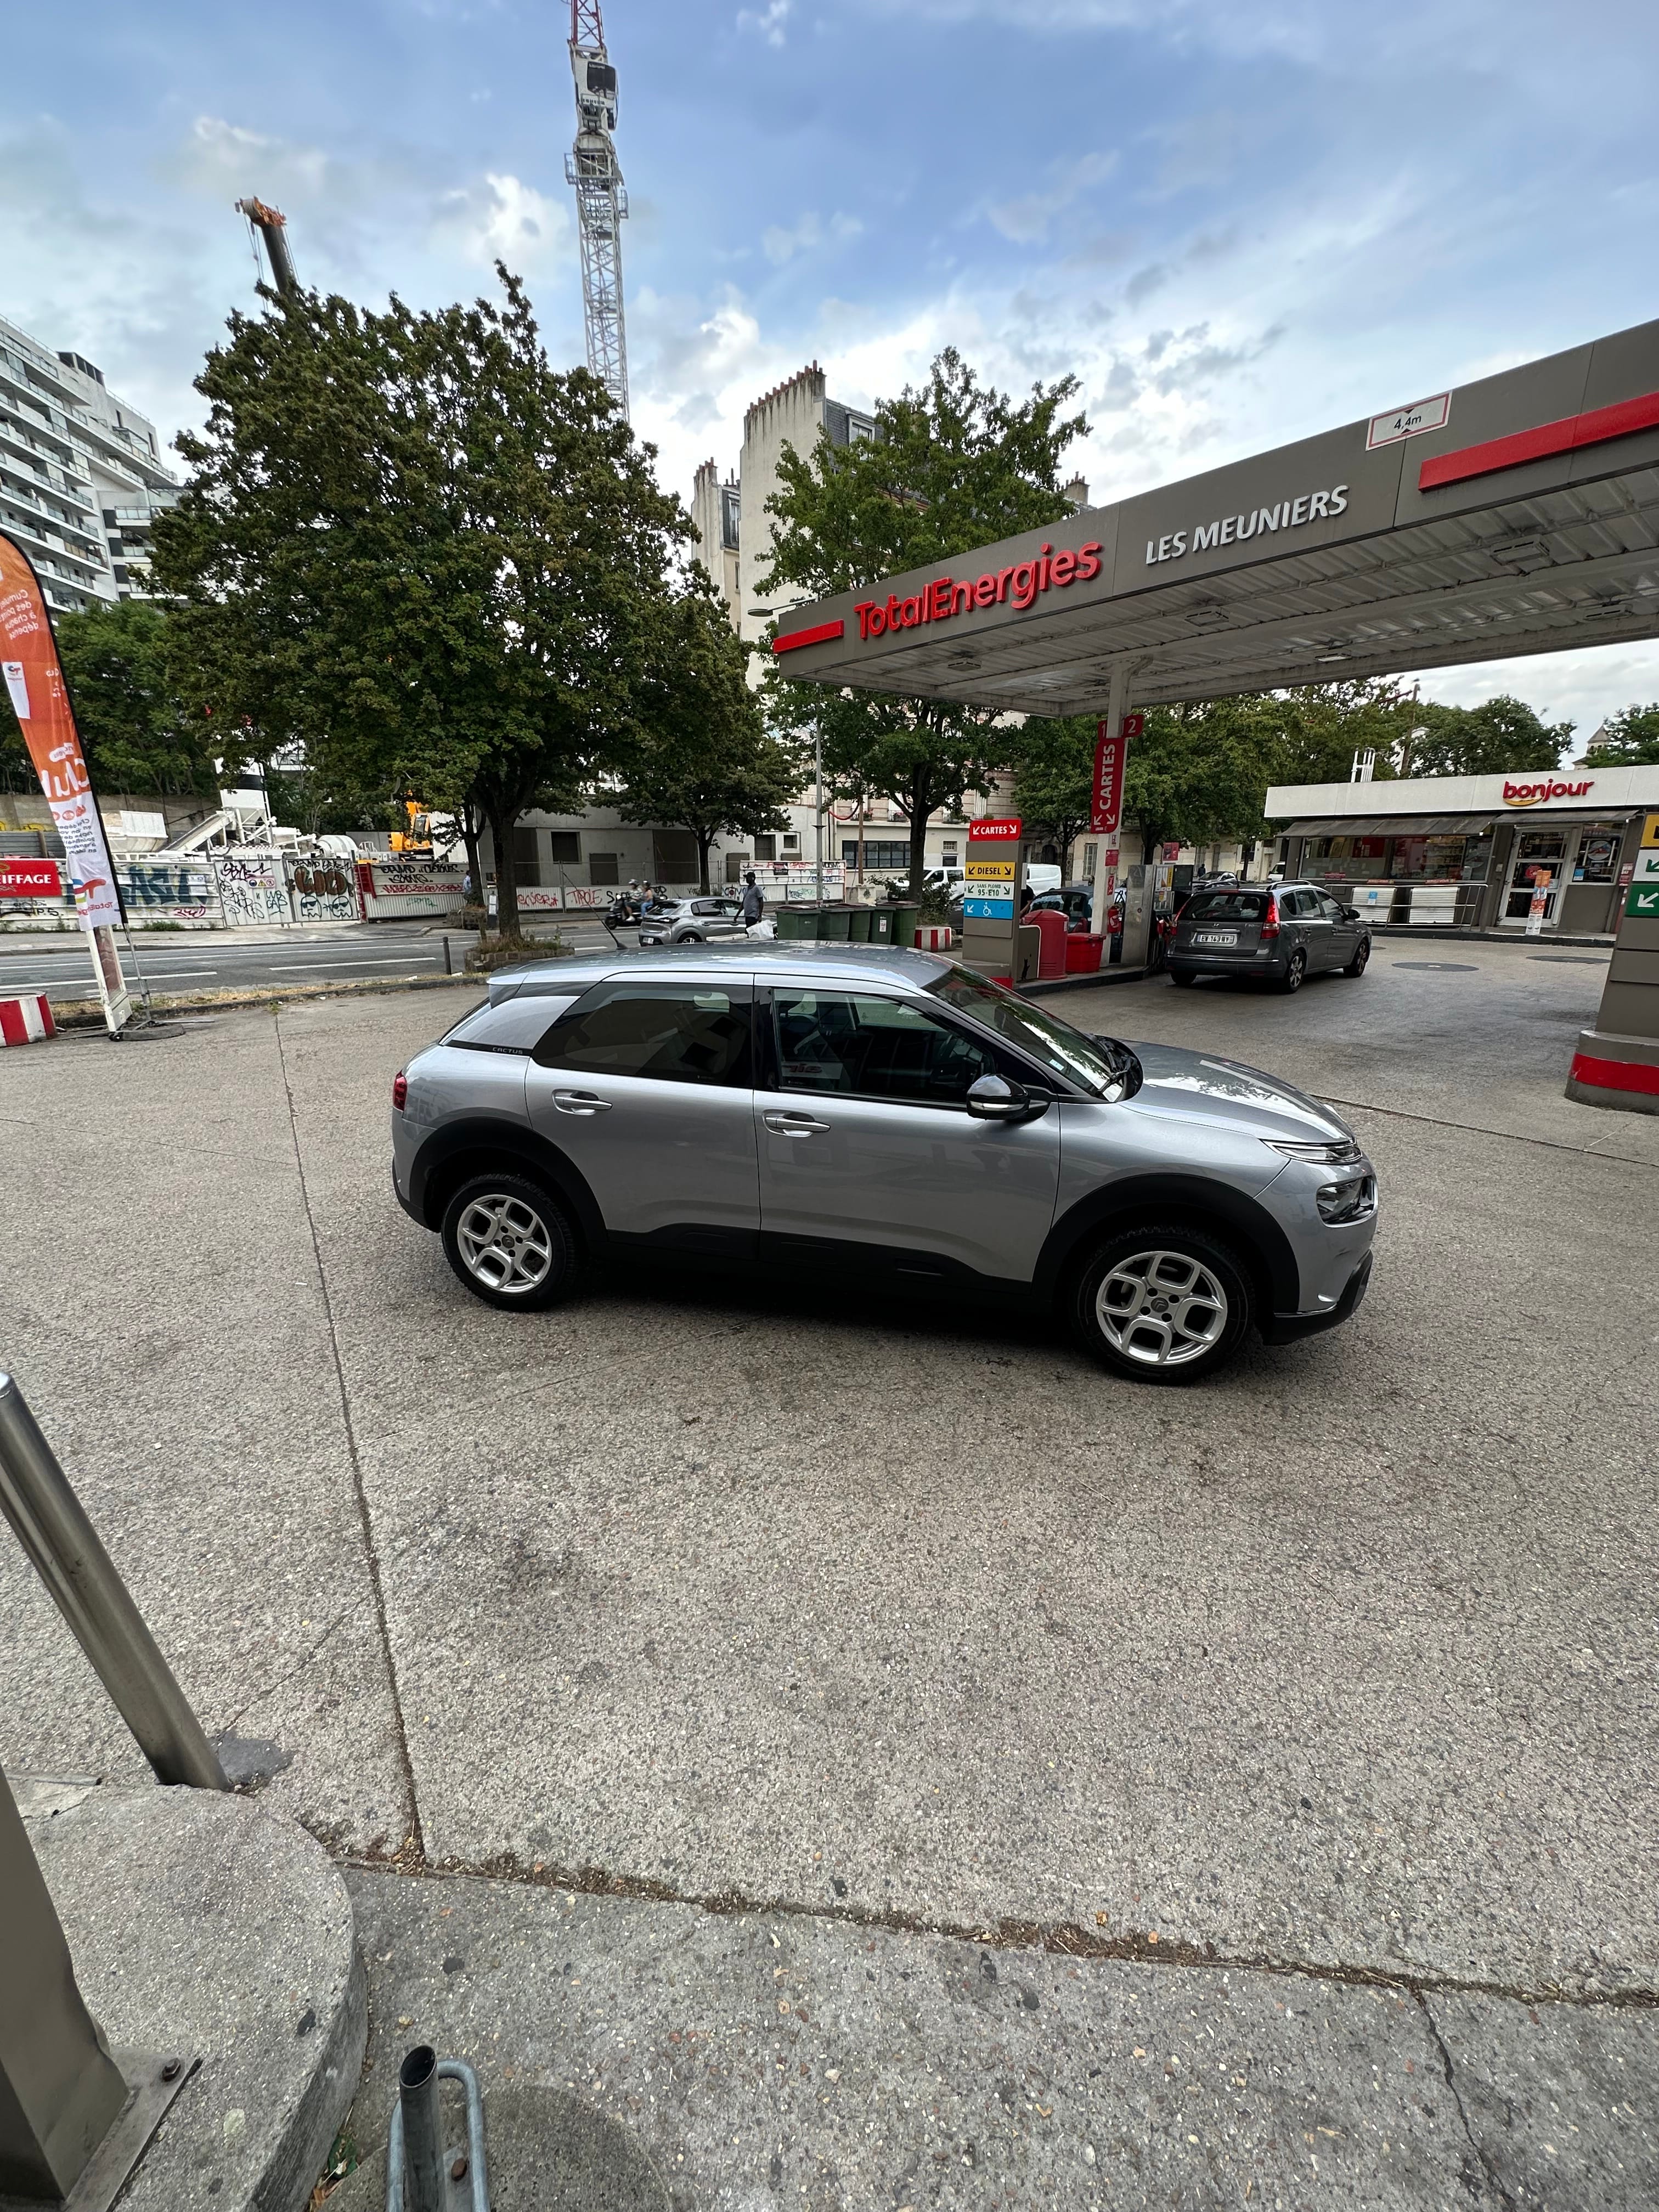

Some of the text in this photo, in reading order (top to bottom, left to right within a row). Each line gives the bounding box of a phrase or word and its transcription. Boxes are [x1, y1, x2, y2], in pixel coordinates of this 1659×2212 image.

[1394, 415, 1421, 430] 4,4m
[1146, 485, 1349, 566] LES MEUNIERS
[854, 541, 1103, 641] TotalEnergies
[1128, 719, 1137, 733] 2
[1099, 744, 1116, 810] CARTES
[1503, 778, 1595, 802] bonjour
[980, 826, 1007, 835] CARTES
[977, 867, 1001, 875] DIESEL
[0, 874, 52, 884] IFFAGE
[493, 1047, 523, 1055] CACTUS
